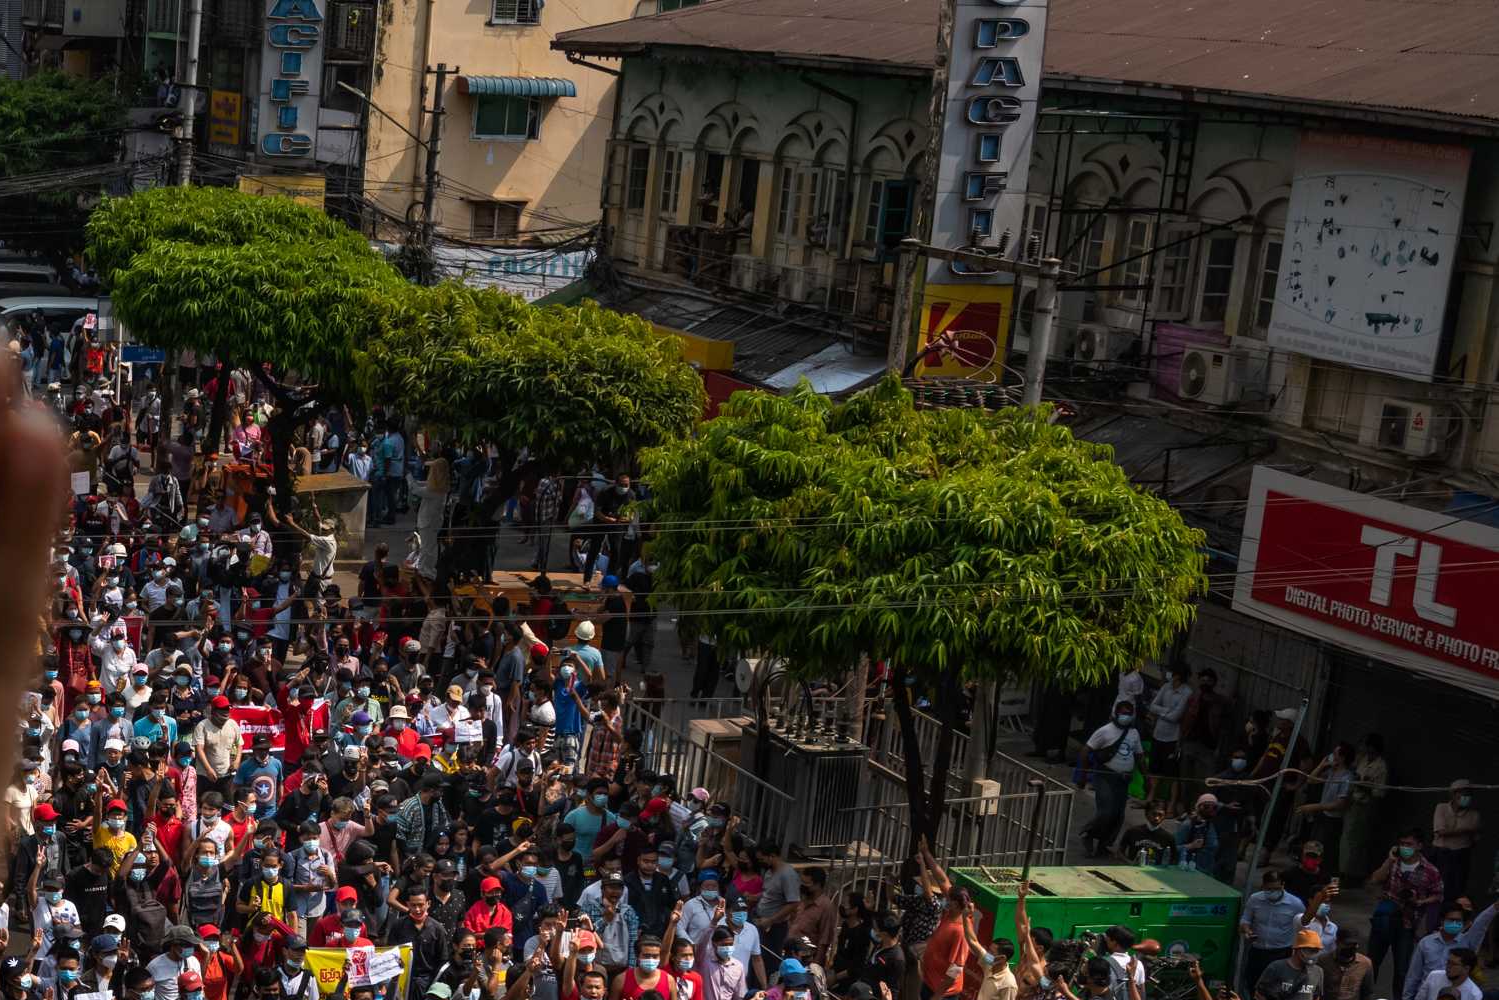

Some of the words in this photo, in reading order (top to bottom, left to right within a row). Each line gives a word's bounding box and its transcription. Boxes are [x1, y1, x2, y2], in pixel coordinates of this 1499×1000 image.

[952, 18, 1029, 275] PACIFIC
[1284, 583, 1329, 615] DIGITAL
[1330, 599, 1371, 627] PHOTO
[1371, 613, 1424, 646] SERVICE
[1424, 629, 1434, 649] &
[1435, 633, 1481, 663] PHOTO
[1360, 524, 1457, 627] TL
